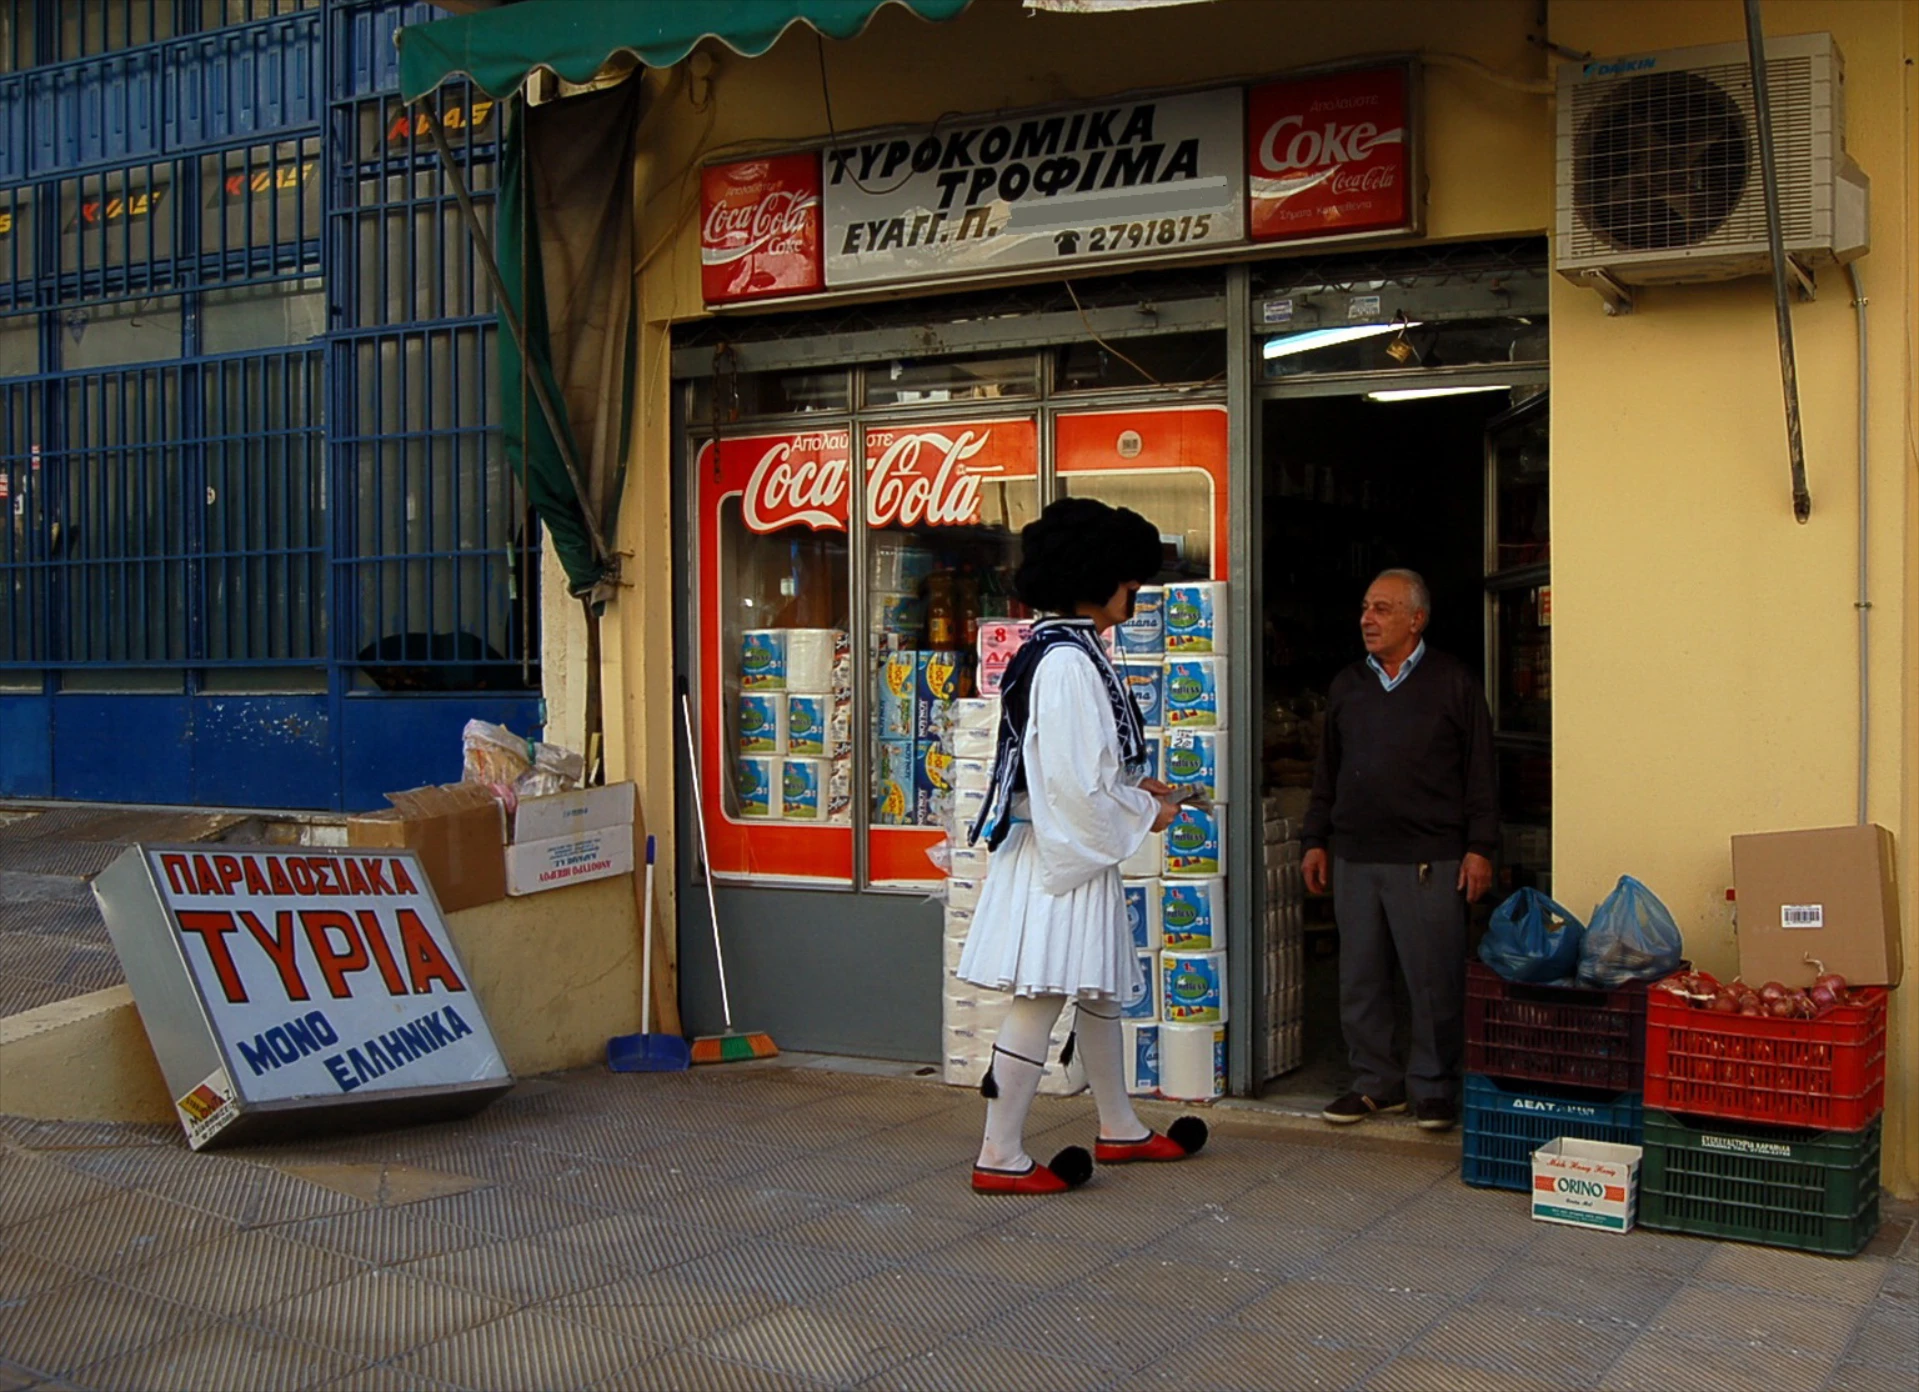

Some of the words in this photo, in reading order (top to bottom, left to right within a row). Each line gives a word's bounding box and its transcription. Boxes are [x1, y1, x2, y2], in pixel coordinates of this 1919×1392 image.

[828, 104, 1156, 185] ΤΥΡΟΚΟΜΙΚΑ
[1259, 114, 1382, 172] Coke
[935, 138, 1200, 210] ΤΡΟΦΙΜΑ
[703, 189, 811, 243] Coca-Cola
[841, 212, 951, 256] ΕΥΑΓΓ.
[1089, 214, 1212, 252] 2791815
[768, 236, 804, 256] Coke
[743, 429, 990, 530] Coca-Cola
[995, 627, 1006, 643] 8
[160, 853, 419, 896] ΠΑΡΑΔΟΣΙΑΚΑ
[174, 909, 467, 1004] ΤΥΡΙΑ
[236, 1010, 339, 1077] ΜΟΝΟ
[322, 1006, 473, 1093] ΕΛΛΗΝΙΚΑ
[1512, 1098, 1561, 1112] ΔΕΛΤ
[1557, 1177, 1603, 1198] ORINO
